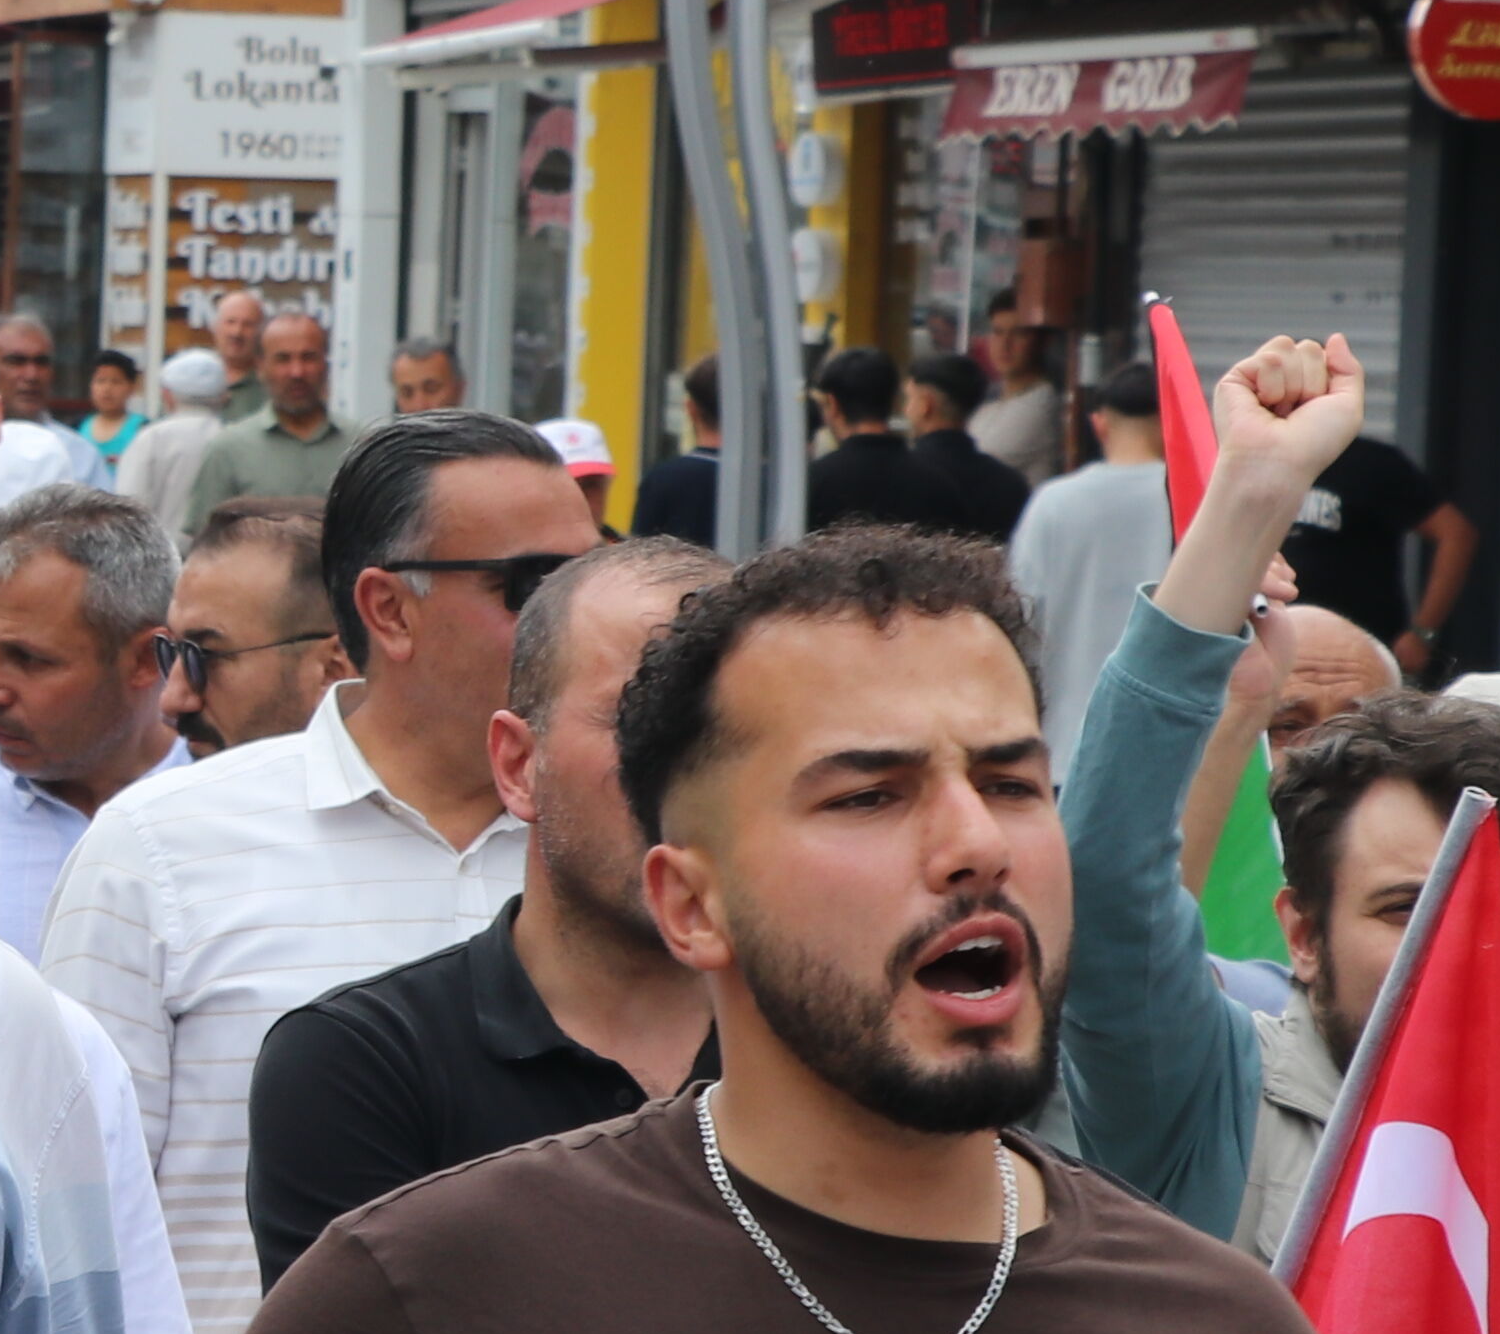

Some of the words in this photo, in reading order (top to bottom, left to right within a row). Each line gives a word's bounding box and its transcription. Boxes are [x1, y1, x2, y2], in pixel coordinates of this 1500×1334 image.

[237, 36, 321, 66] Bolu
[982, 63, 1081, 118] EREN
[1103, 56, 1197, 113] GOLD
[219, 130, 299, 160] 1960
[177, 188, 294, 235] Testi
